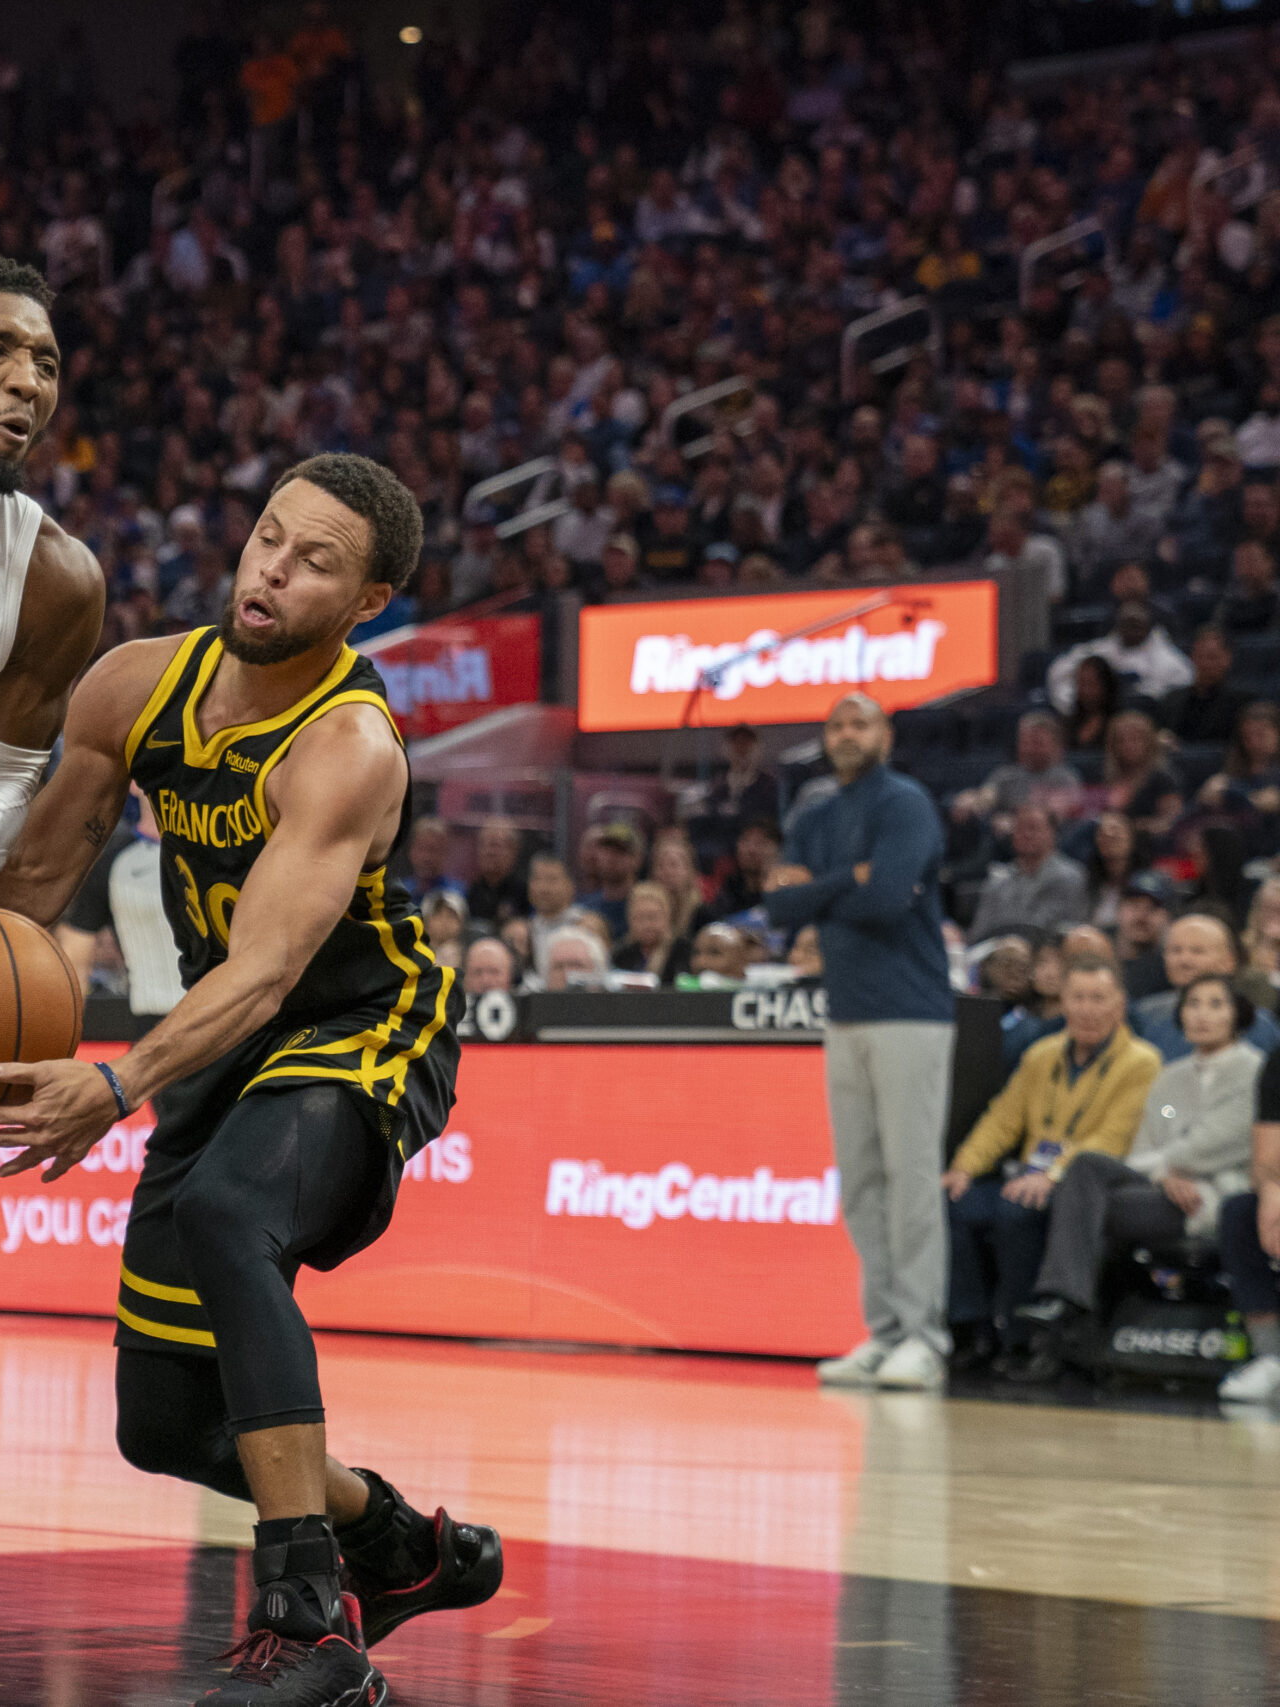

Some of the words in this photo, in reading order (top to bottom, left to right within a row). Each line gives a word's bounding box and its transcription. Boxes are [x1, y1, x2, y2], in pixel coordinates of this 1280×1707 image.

[631, 620, 942, 699] RingCentral
[225, 750, 260, 775] Rakuten
[159, 788, 262, 849] FRANCISCO
[732, 989, 830, 1030] CHAS
[546, 1160, 841, 1229] RingCentral
[1, 1197, 84, 1254] you
